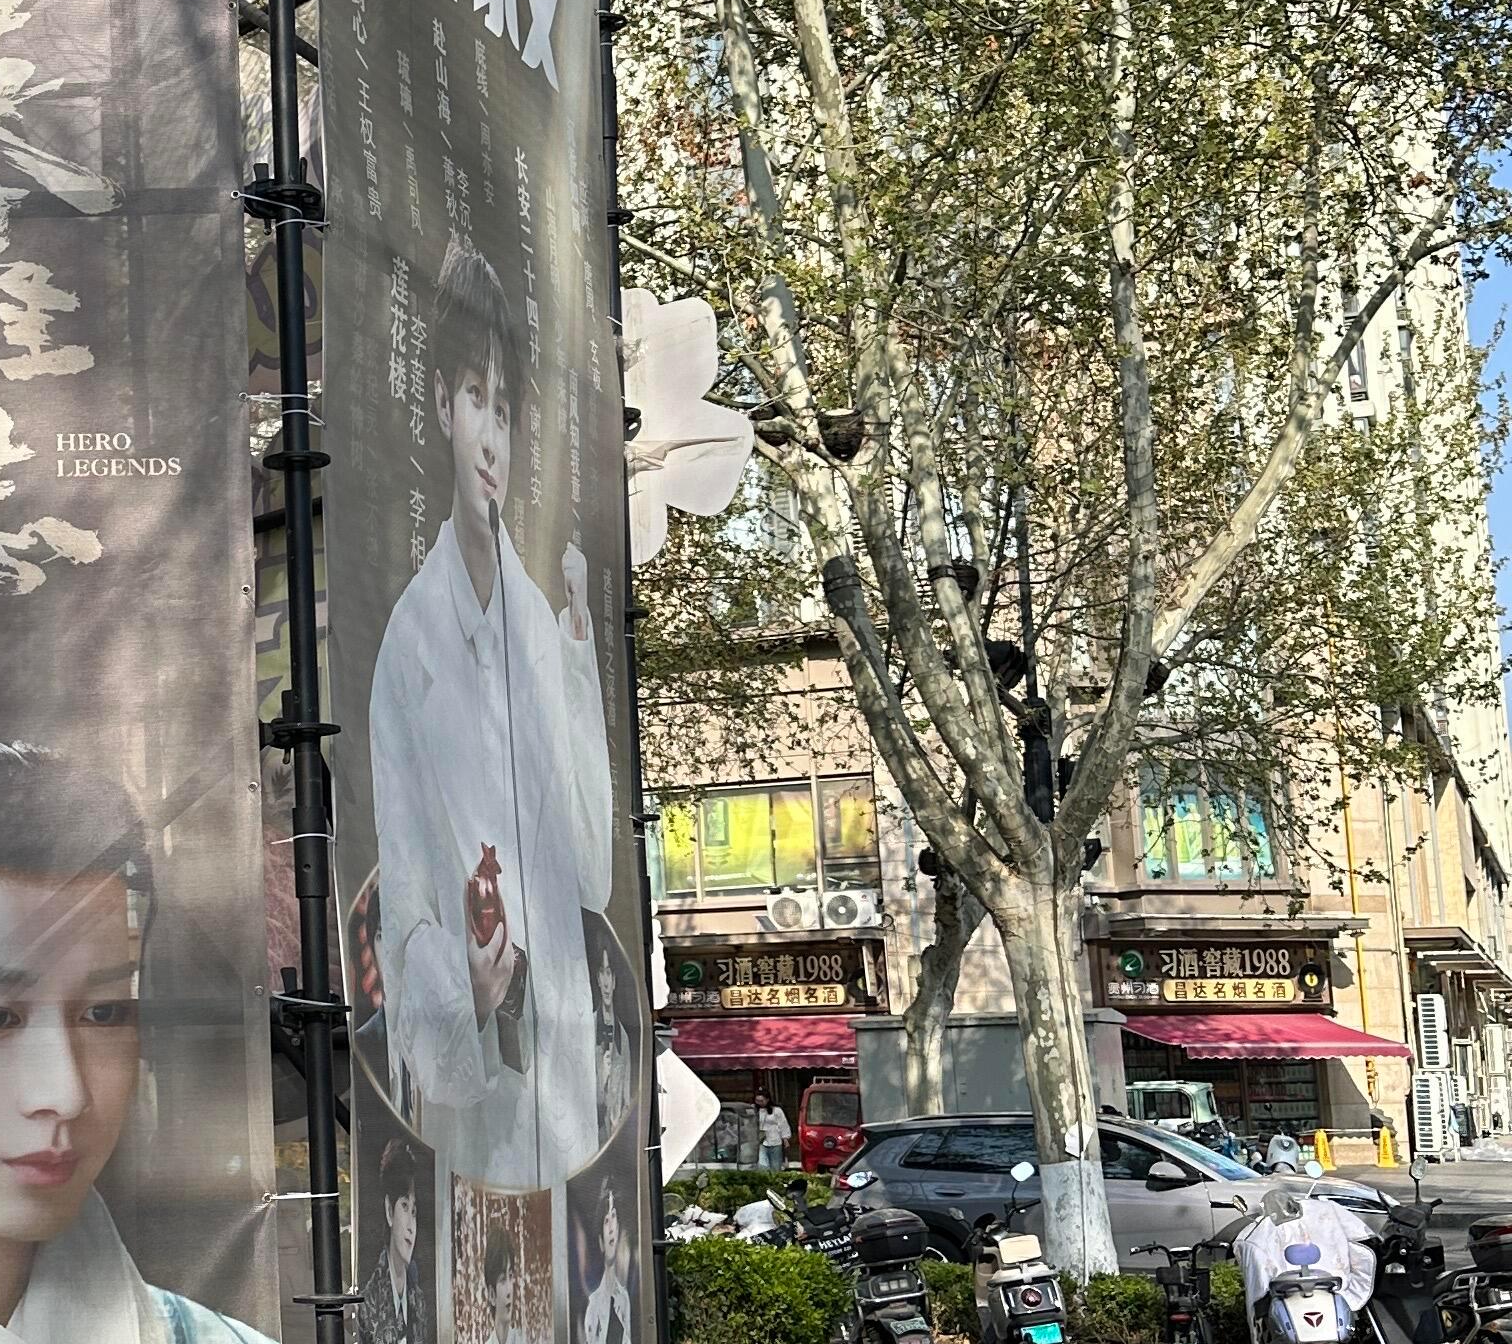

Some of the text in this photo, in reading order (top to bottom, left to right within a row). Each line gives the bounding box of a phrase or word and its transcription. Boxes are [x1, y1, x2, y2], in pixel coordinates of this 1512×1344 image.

[388, 252, 408, 404] 莲花楼
[55, 432, 132, 453] HERO
[55, 456, 183, 478] LEGENDS
[729, 986, 839, 1006] 昌达名烟名酒
[1174, 981, 1286, 1000] 昌达名烟名酒
